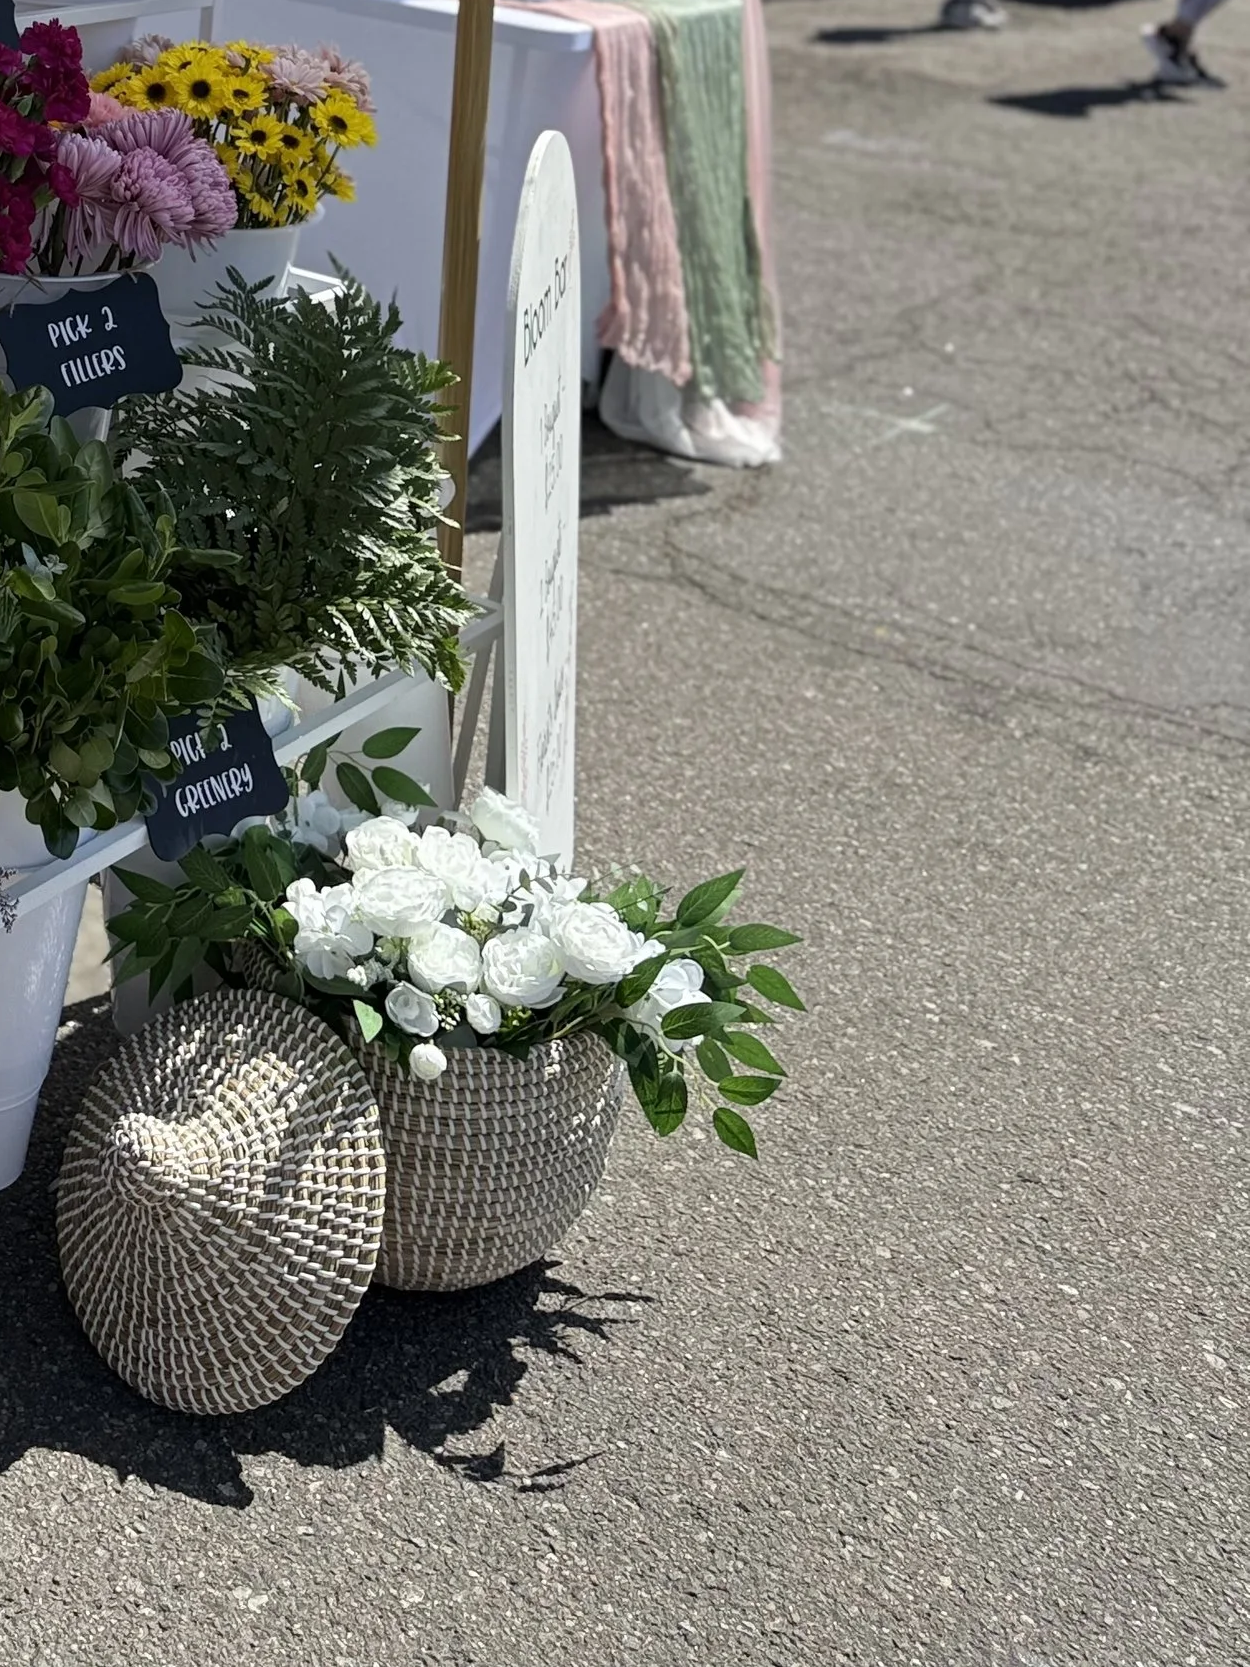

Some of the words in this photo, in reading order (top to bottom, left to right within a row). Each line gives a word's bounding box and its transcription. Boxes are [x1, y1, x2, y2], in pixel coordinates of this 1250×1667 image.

[47, 313, 93, 349] PICK
[101, 305, 118, 332] 2
[523, 283, 552, 368] Bloom
[60, 344, 127, 388] FILLERS
[216, 723, 233, 752] 2
[174, 762, 254, 818] GREENERY
